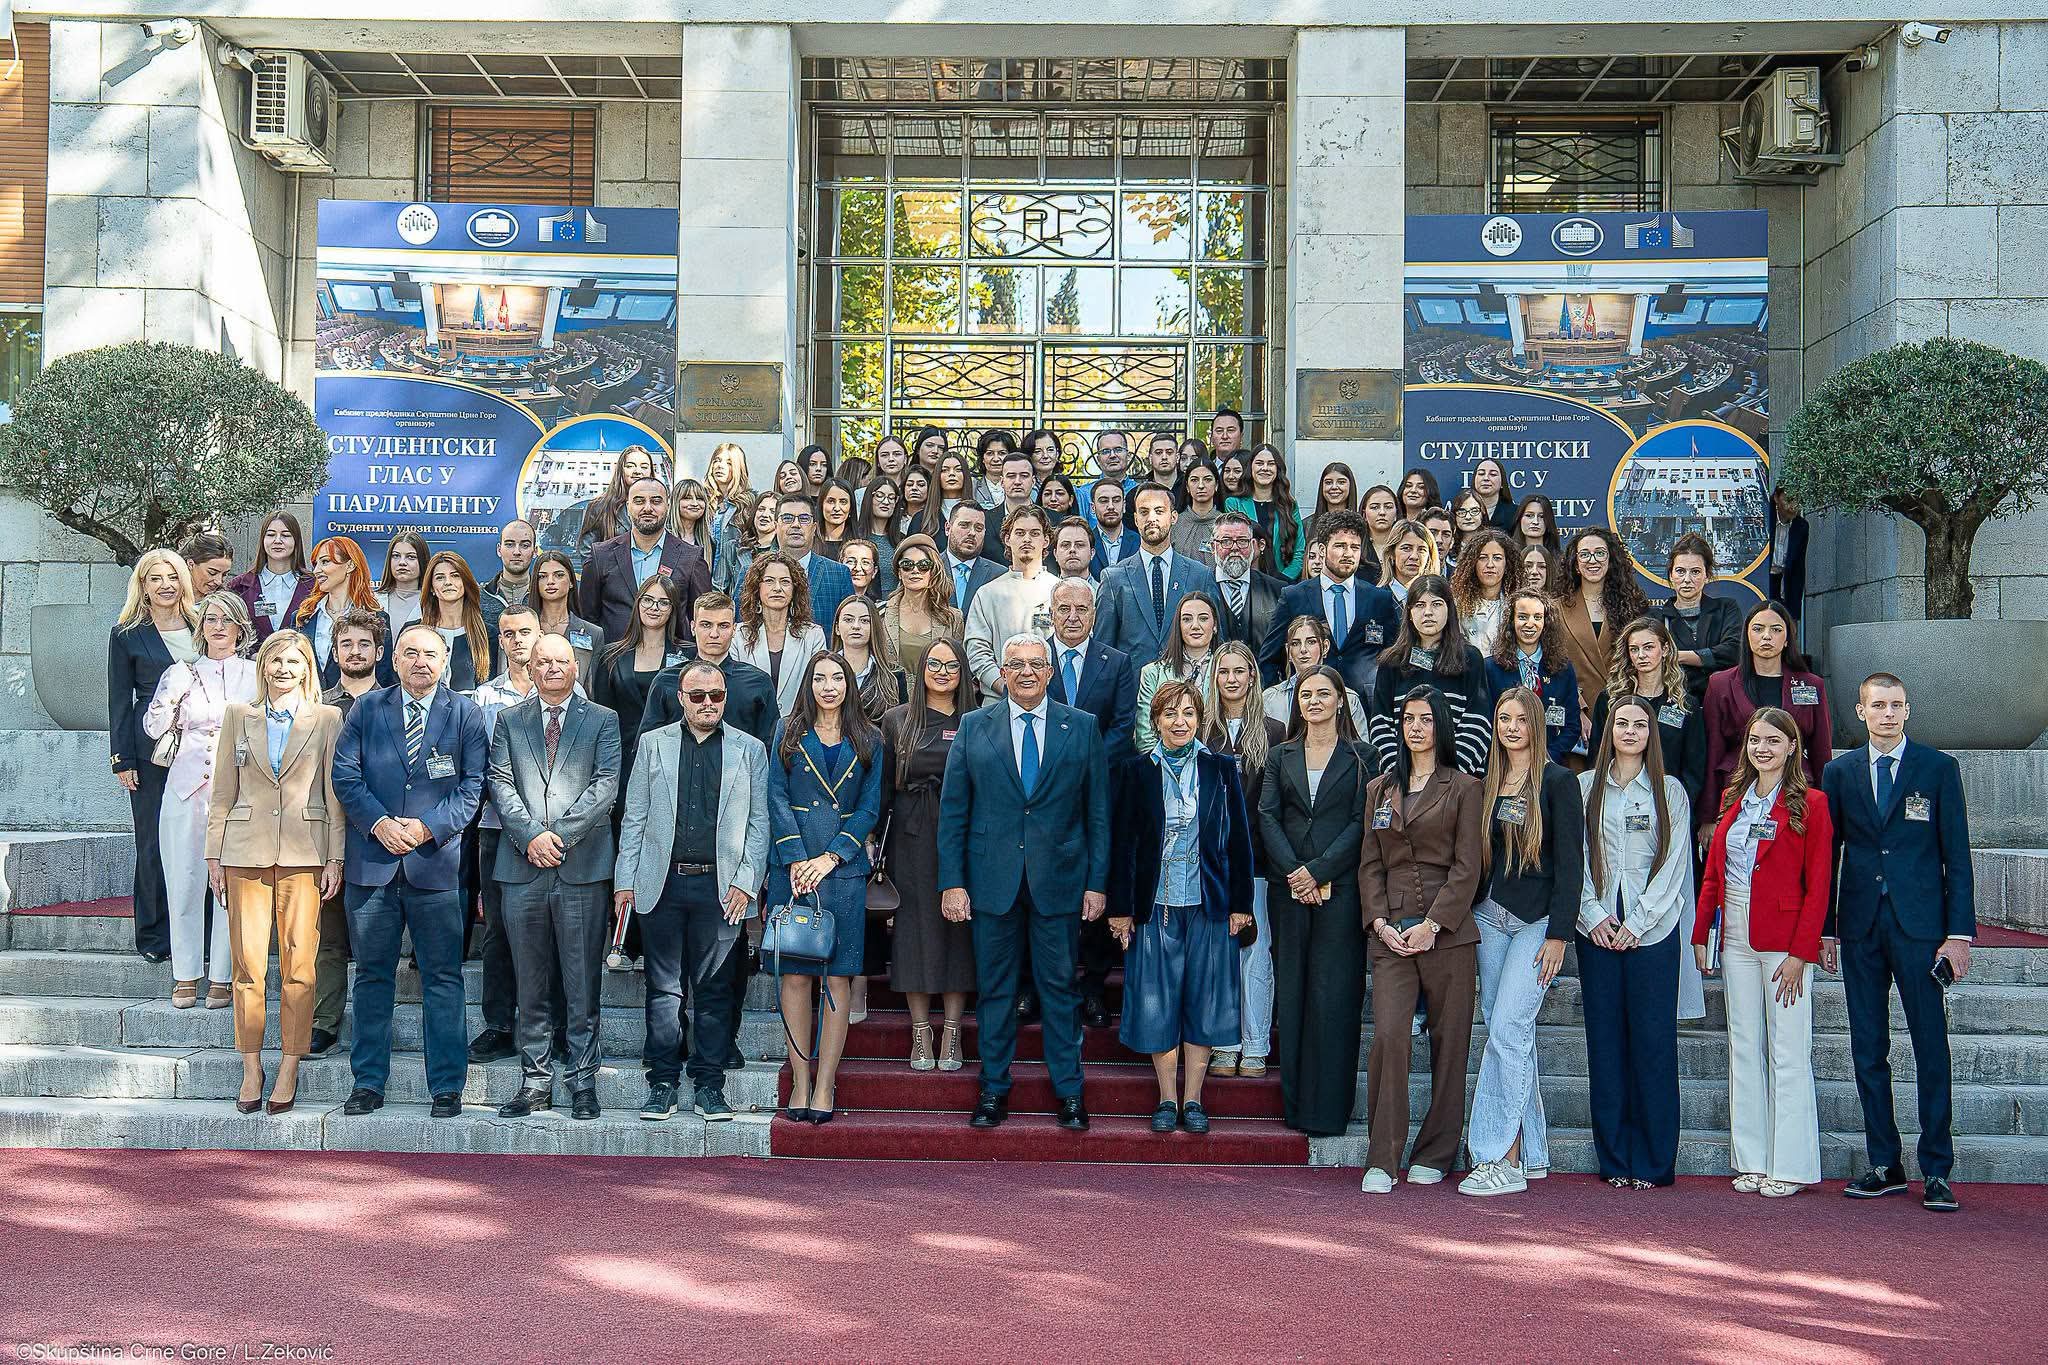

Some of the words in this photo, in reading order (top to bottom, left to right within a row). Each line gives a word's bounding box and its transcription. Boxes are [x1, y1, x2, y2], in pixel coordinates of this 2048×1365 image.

[1311, 419, 1386, 429] СКУПШТИНА
[1508, 414, 1551, 423] Скупштине
[1572, 414, 1590, 422] Горе
[327, 435, 497, 458] СТУДЕНТСКИ
[1419, 440, 1591, 463] СТУДЕНТСКИ
[367, 465, 433, 485] ГЛАС
[438, 466, 456, 485] У
[1461, 470, 1527, 489] ГС
[1532, 470, 1549, 488] У
[327, 494, 501, 515] ПАРЛАМЕНТУ
[327, 521, 384, 534] Студенти
[386, 524, 394, 534] у
[434, 525, 499, 534] посланика
